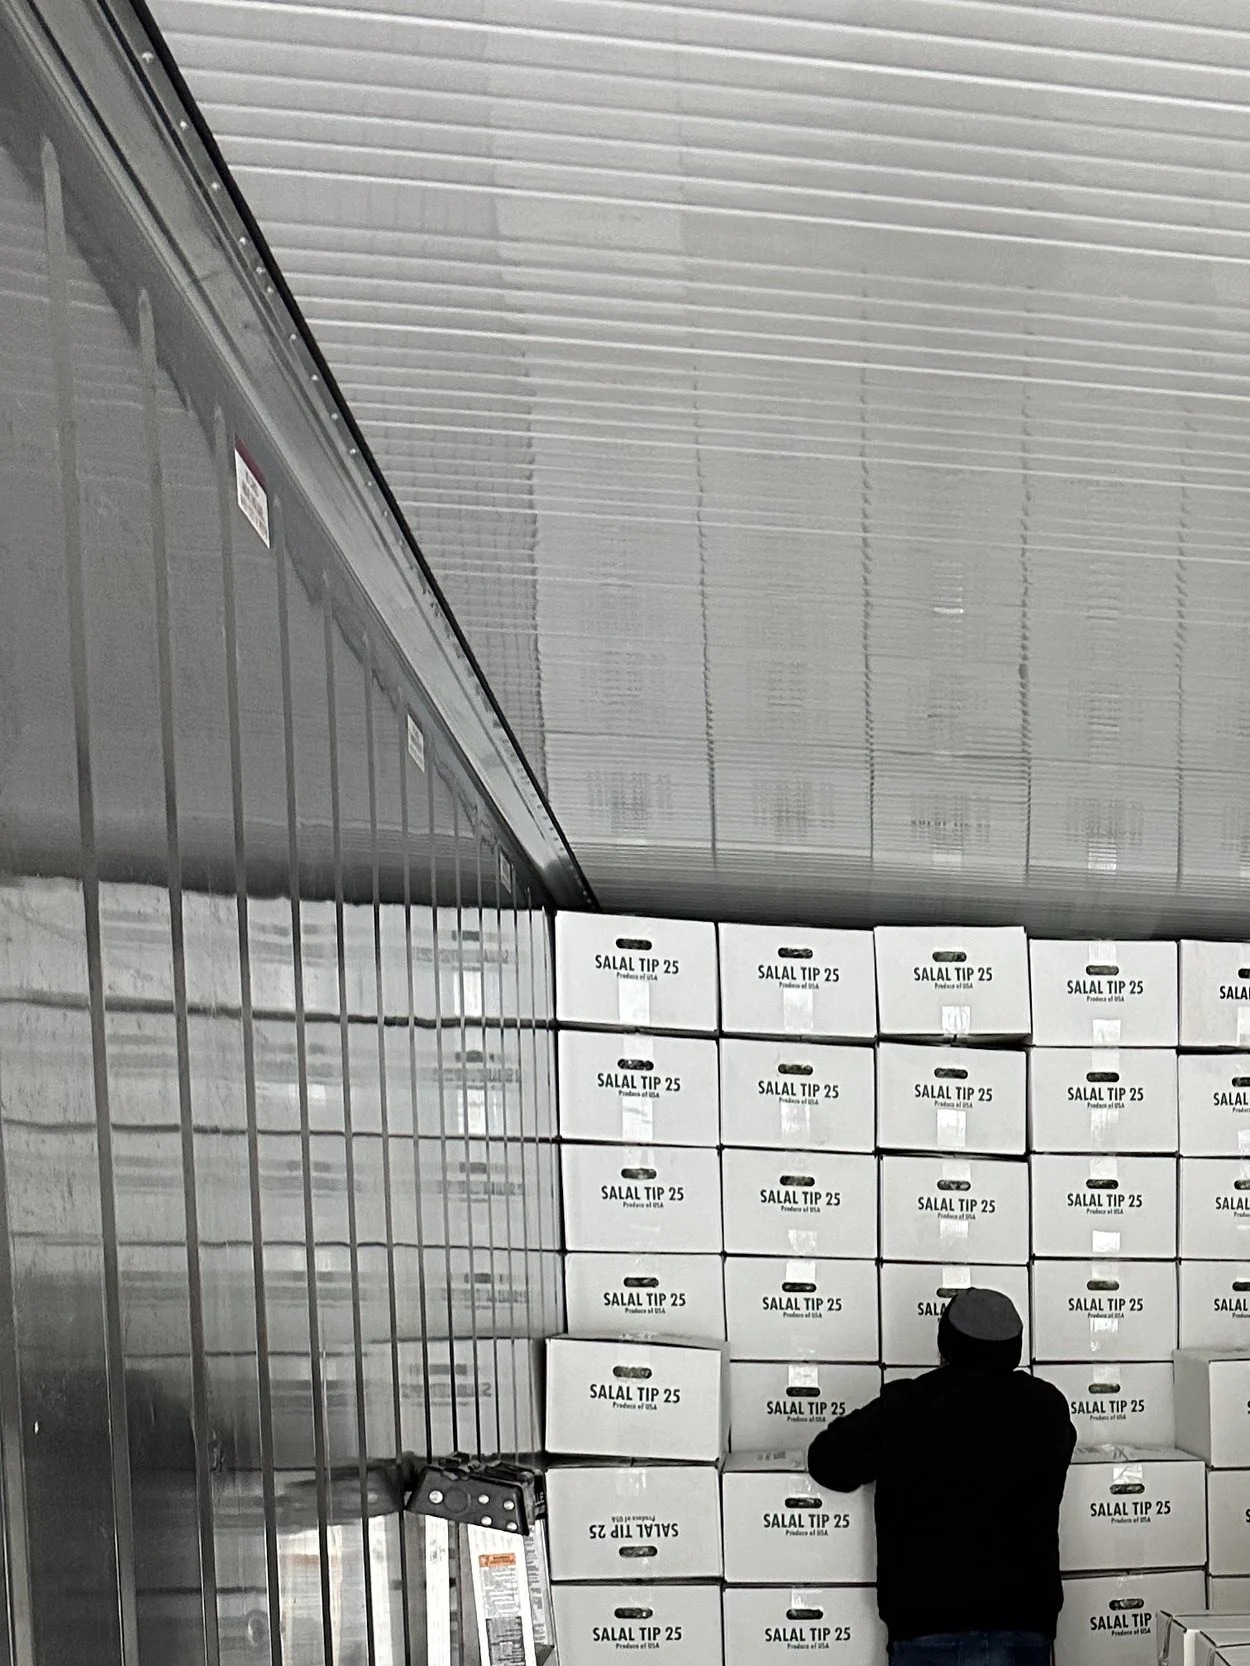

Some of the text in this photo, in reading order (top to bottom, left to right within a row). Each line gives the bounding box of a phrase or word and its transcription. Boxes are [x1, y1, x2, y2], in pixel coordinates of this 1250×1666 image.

[594, 954, 679, 975] SALAL TIP 25
[758, 964, 840, 983] SALAL TIP 25
[913, 966, 993, 982] SALAL TIP 25
[1067, 980, 1144, 995] SALAL TIP 25
[597, 1072, 681, 1092] SALAL TIP 25
[758, 1080, 839, 1099] SALAL TIP 25
[914, 1084, 993, 1102] SALAL TIP 25
[1067, 1086, 1144, 1102] SALAL TIP 25
[1213, 1092, 1249, 1106] SALAL
[601, 1185, 684, 1201] SALAL TIP 25
[760, 1189, 841, 1206] SALAL TIP 25
[1067, 1193, 1143, 1208] SALAL TIP 25
[918, 1196, 996, 1214] SALAL TIP 25
[1215, 1196, 1250, 1211] SALAL
[603, 1292, 686, 1307] SALAL TIP 25
[762, 1296, 842, 1312] SALAL TIP 25
[1068, 1298, 1144, 1312] SALAL TIP 25
[1214, 1298, 1248, 1312] SALAL
[590, 1383, 680, 1404] SALAL TIP 25
[766, 1401, 846, 1415] SALAL TIP 25
[1070, 1399, 1145, 1415] SALAL TIP 25
[1090, 1500, 1171, 1517] SALAL TIP 25
[763, 1513, 850, 1529] SALAL TIP 25
[589, 1522, 679, 1540] SALAL TIP 25
[1090, 1612, 1152, 1631] SALAL TIP
[592, 1626, 682, 1642] SALAL TIP 25
[764, 1626, 851, 1642] SALAL TIP 25
